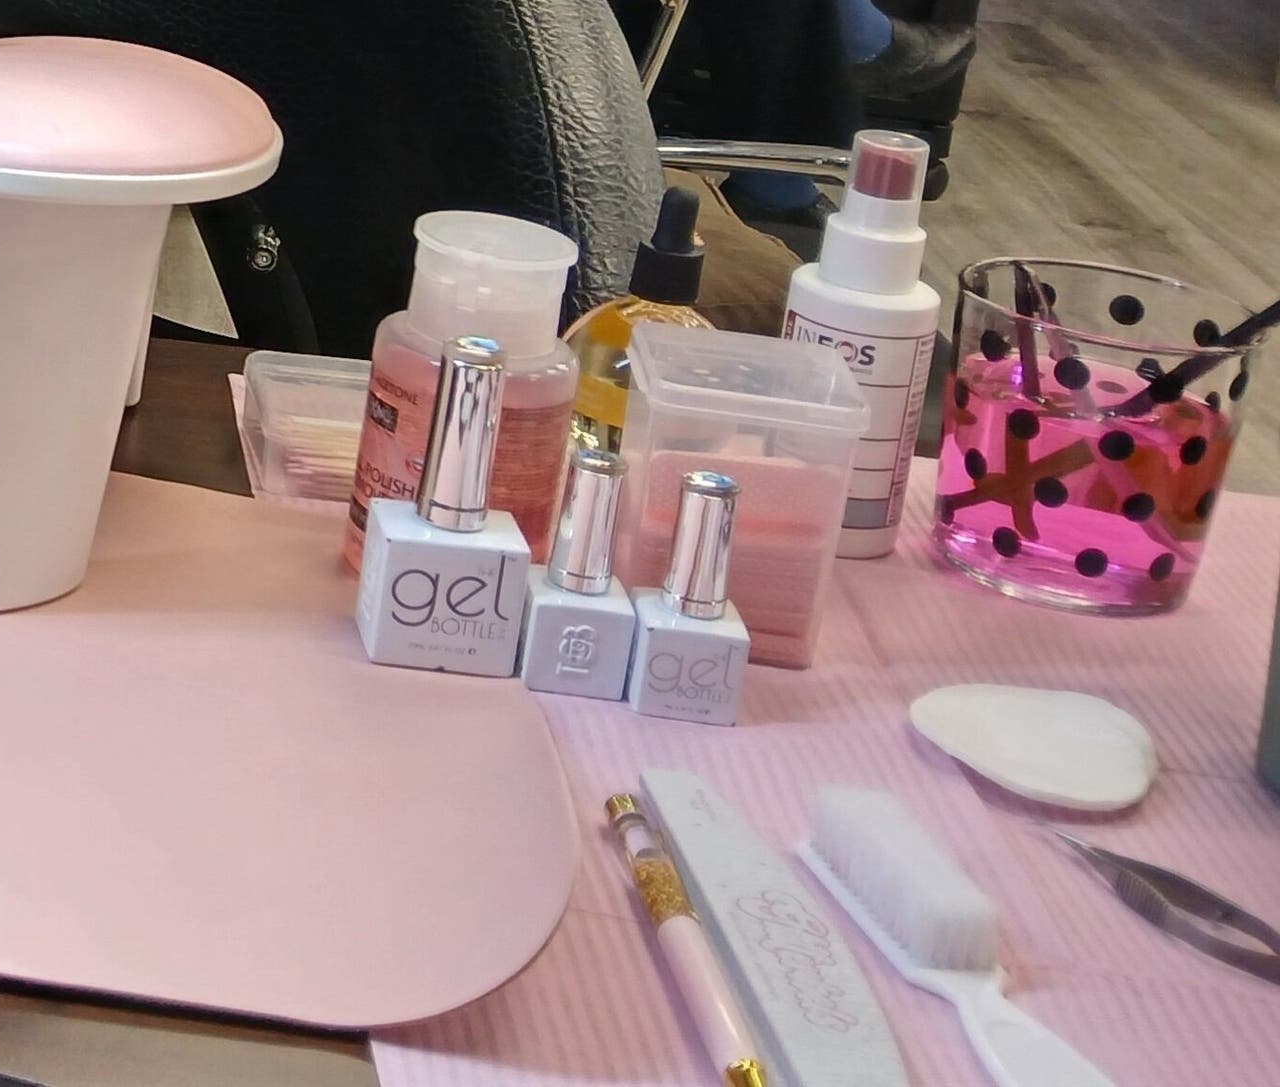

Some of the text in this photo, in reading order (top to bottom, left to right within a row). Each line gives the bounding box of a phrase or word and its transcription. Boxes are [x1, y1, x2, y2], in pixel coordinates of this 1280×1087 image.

[365, 463, 416, 502] POLISH
[391, 554, 509, 627] gel
[431, 617, 496, 641] BOTTLE
[648, 644, 734, 694] gel
